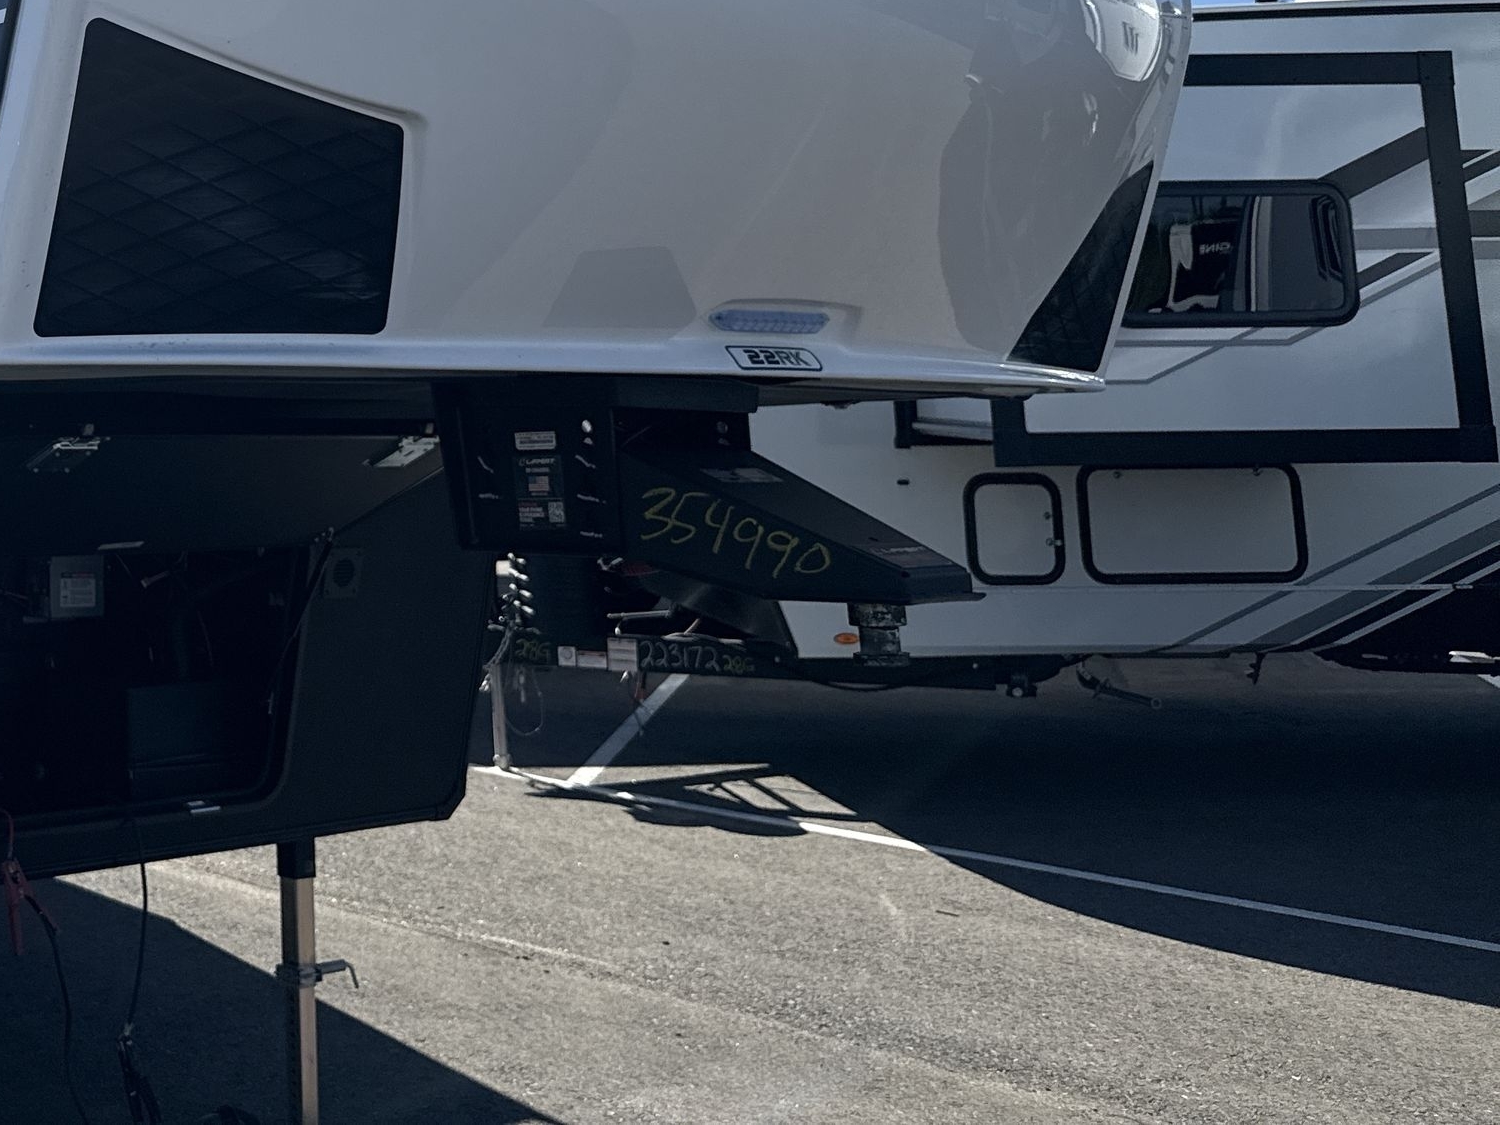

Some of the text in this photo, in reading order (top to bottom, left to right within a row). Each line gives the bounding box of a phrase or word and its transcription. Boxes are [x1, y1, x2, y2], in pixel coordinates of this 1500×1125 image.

[742, 348, 812, 367] 22RK
[640, 486, 831, 579] 354990
[638, 640, 722, 672] 223172
